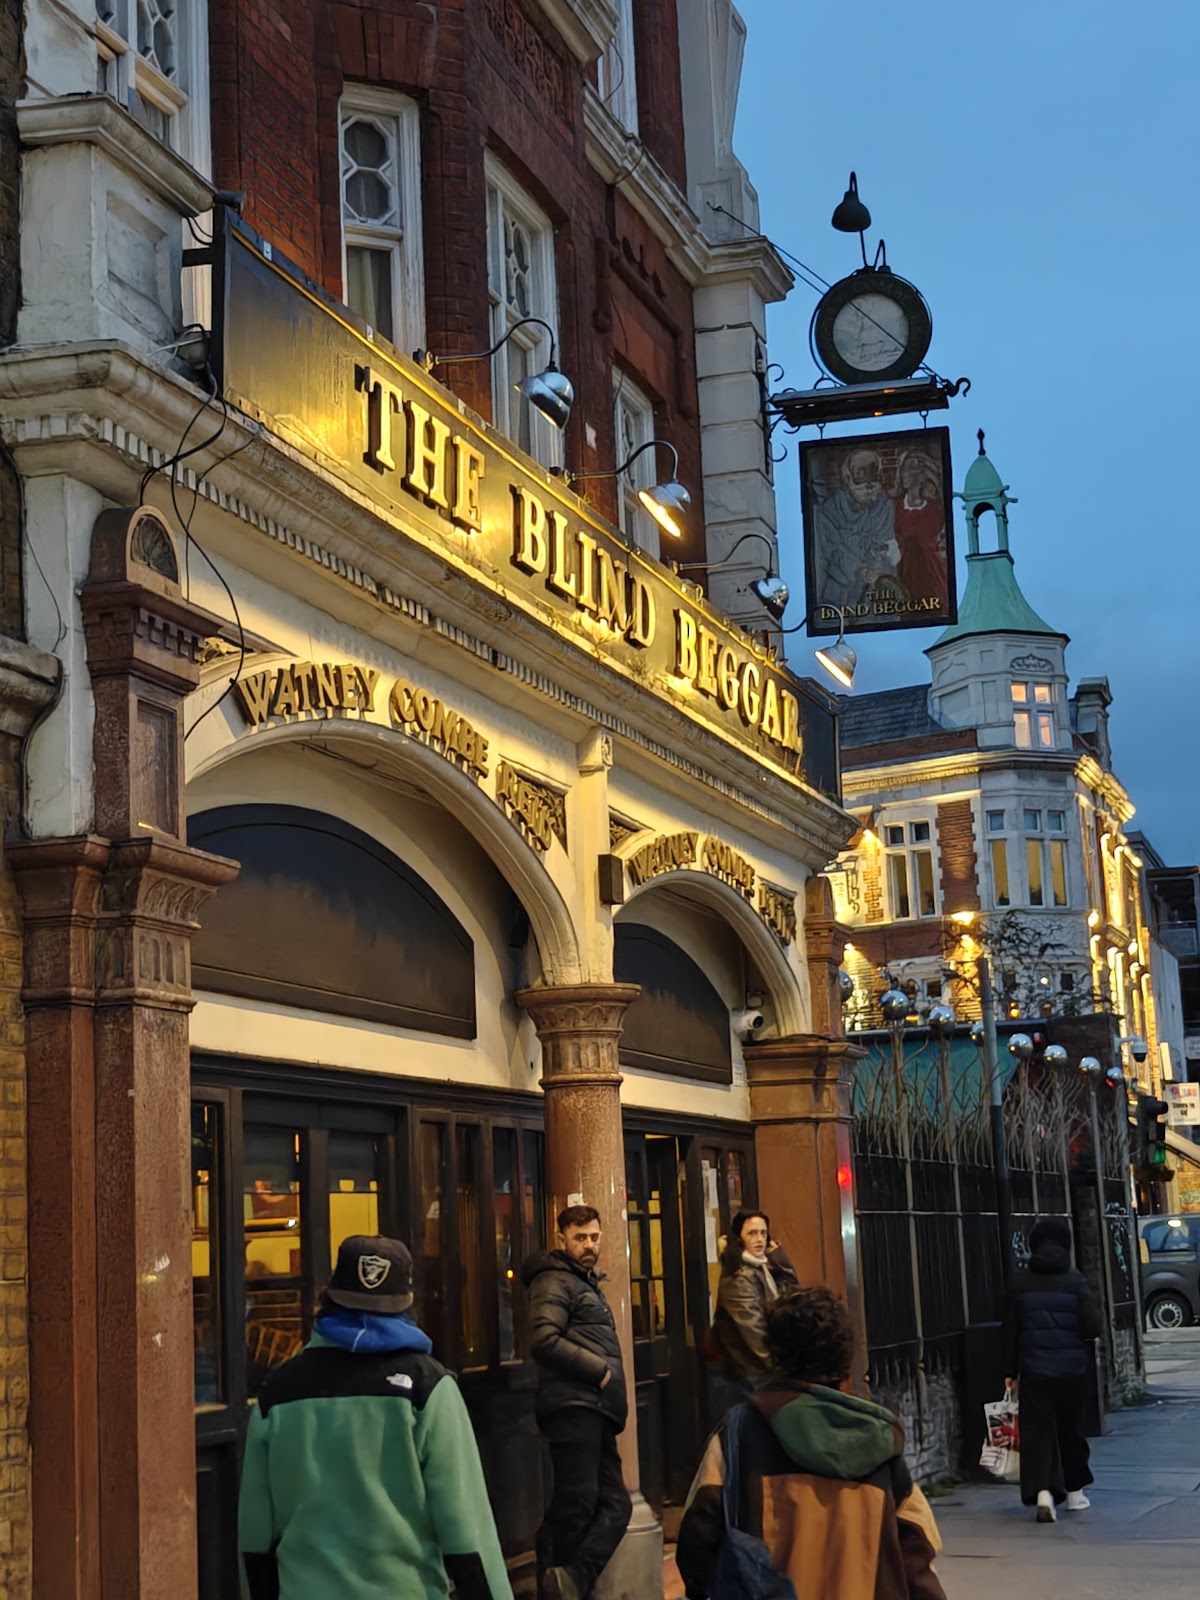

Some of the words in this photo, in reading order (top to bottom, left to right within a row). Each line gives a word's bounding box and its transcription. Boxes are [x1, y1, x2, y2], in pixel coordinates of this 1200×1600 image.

[359, 364, 486, 534] THE
[515, 486, 657, 650] BLIND
[674, 608, 804, 757] BEGGAR
[865, 589, 896, 602] THE
[821, 603, 869, 620] BLIND
[873, 597, 941, 616] BEGGAR
[238, 661, 381, 727] WATNEY
[389, 677, 490, 779] COMBE
